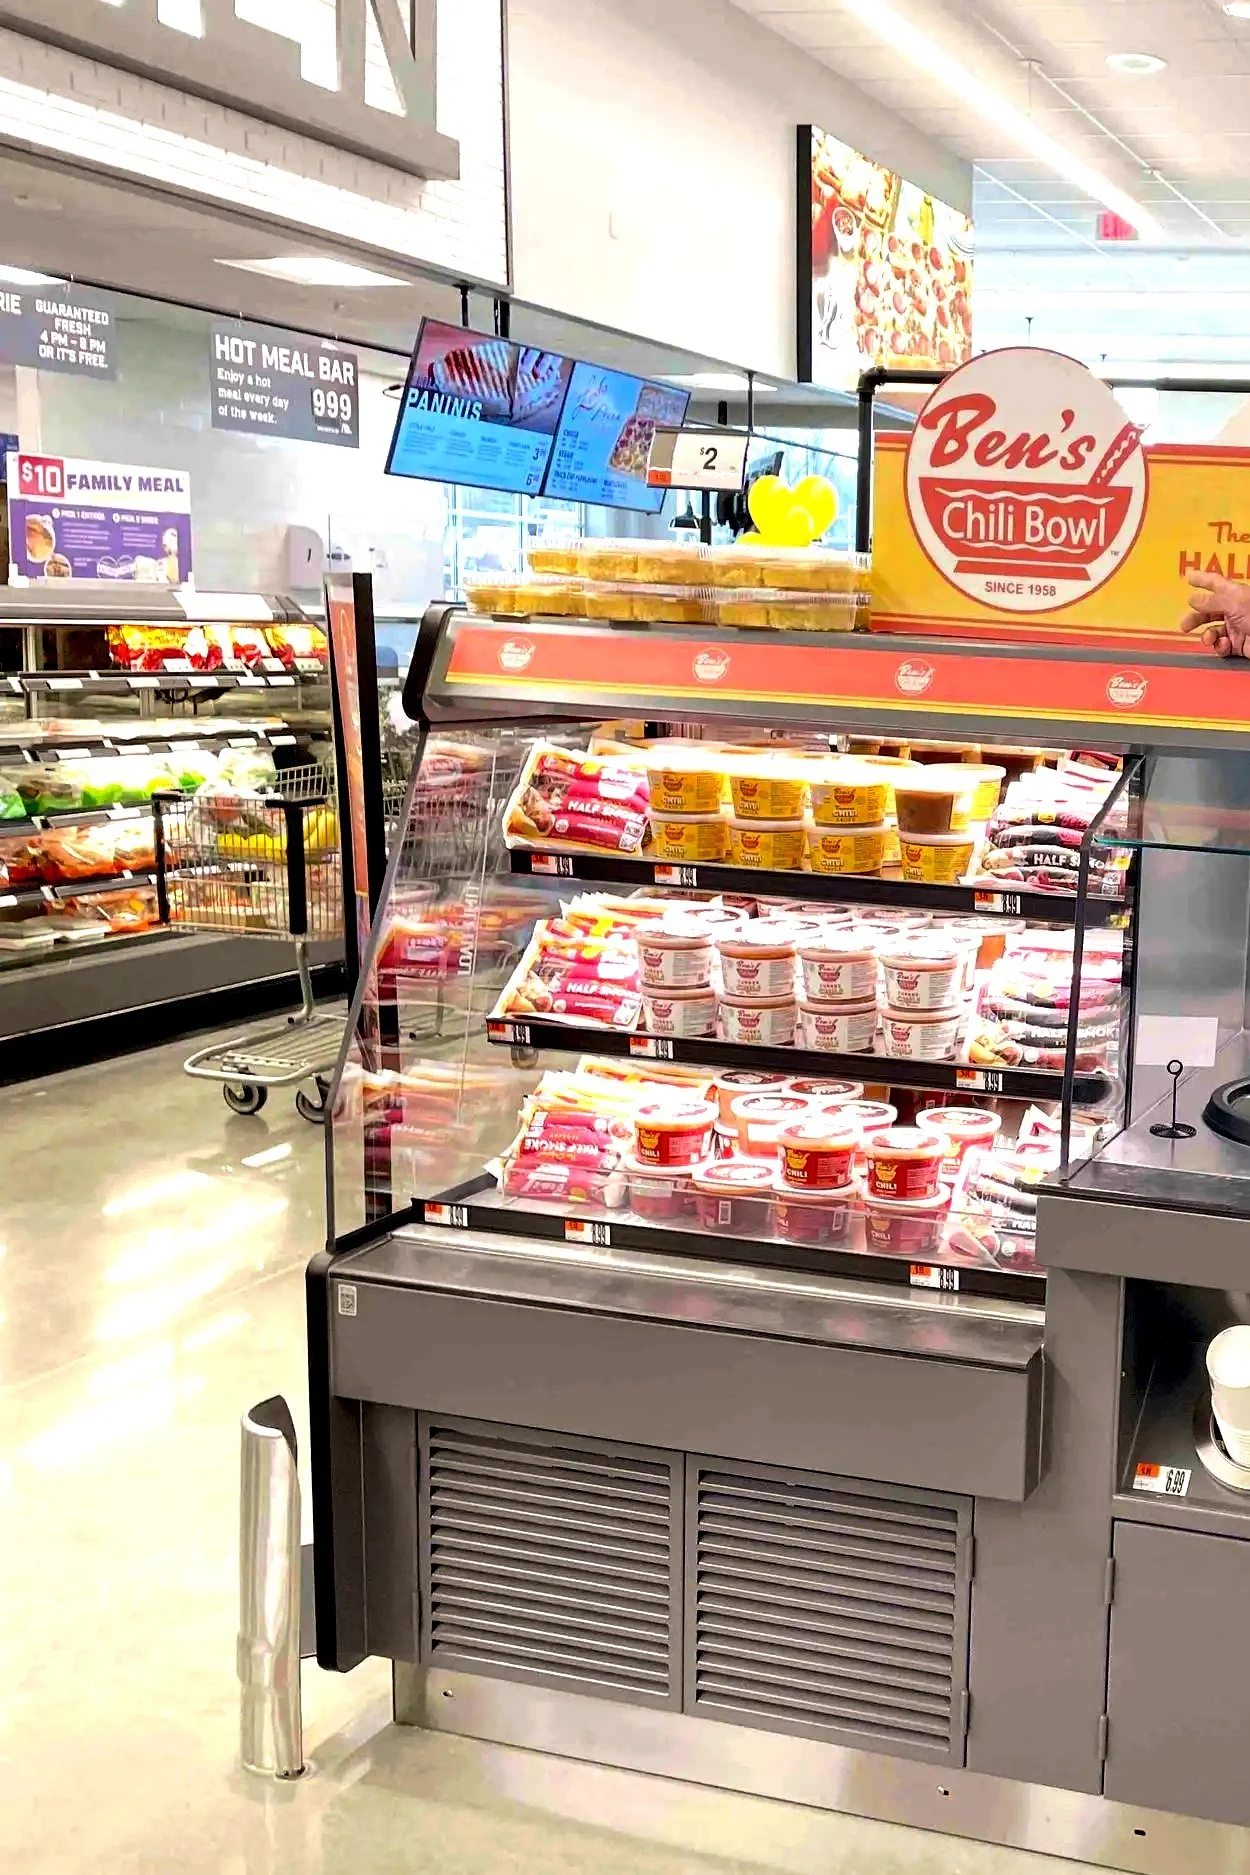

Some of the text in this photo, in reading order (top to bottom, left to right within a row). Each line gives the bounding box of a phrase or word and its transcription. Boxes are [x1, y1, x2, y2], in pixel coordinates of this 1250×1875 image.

[35, 299, 109, 325] GUARANTEED
[54, 317, 91, 336] FRESH
[40, 330, 48, 344] 4
[51, 331, 68, 347] PM
[89, 338, 106, 353] PM
[38, 344, 108, 369] OR IT'S FREE.
[215, 334, 355, 386] HOT MEAL BAR
[217, 368, 271, 388] Enjoy a hot
[218, 388, 289, 411] meal every day
[312, 388, 352, 421] 999
[406, 387, 483, 421] PANINIS
[218, 405, 228, 416] of
[231, 407, 246, 420] the
[920, 393, 1096, 470] Ben's
[700, 447, 718, 470] $2
[21, 461, 185, 493] $10 FAMILY MEAL
[942, 501, 1105, 546] Chili Bowl
[985, 581, 1057, 596] SINCE 1958
[567, 800, 599, 812] HALF
[1033, 853, 1067, 866] HALF
[786, 1170, 808, 1179] CHILI
[876, 1182, 897, 1190] CHILI
